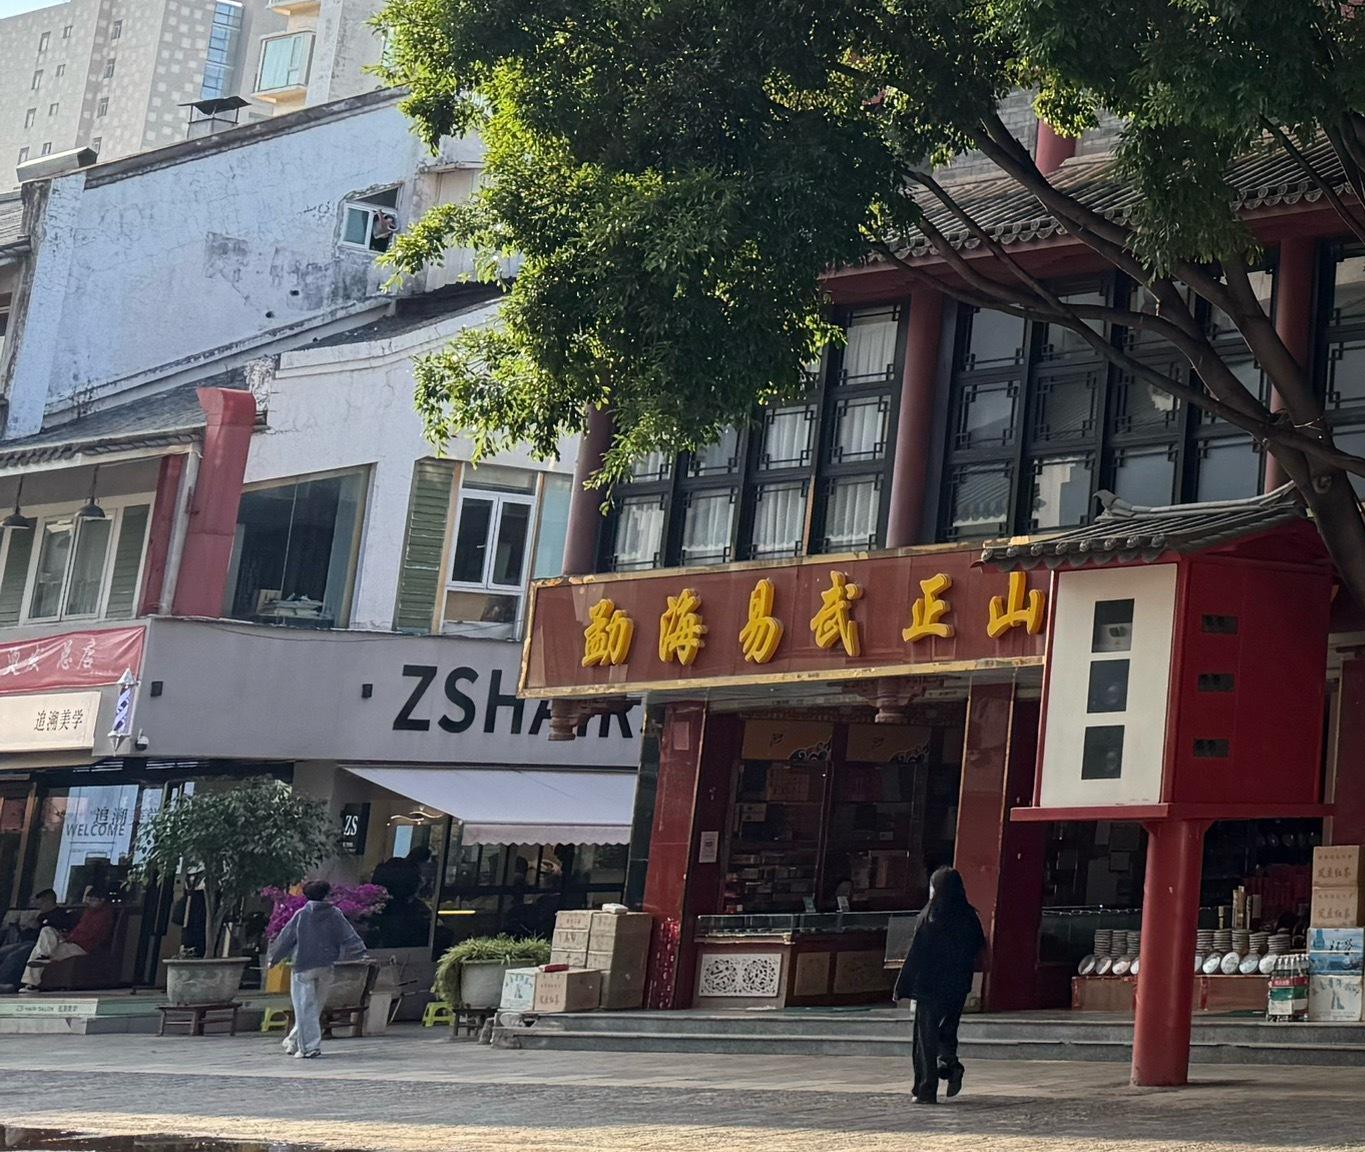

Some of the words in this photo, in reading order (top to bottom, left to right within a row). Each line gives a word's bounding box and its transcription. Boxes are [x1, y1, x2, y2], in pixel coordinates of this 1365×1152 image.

[581, 570, 1047, 667] 勐海易武正山
